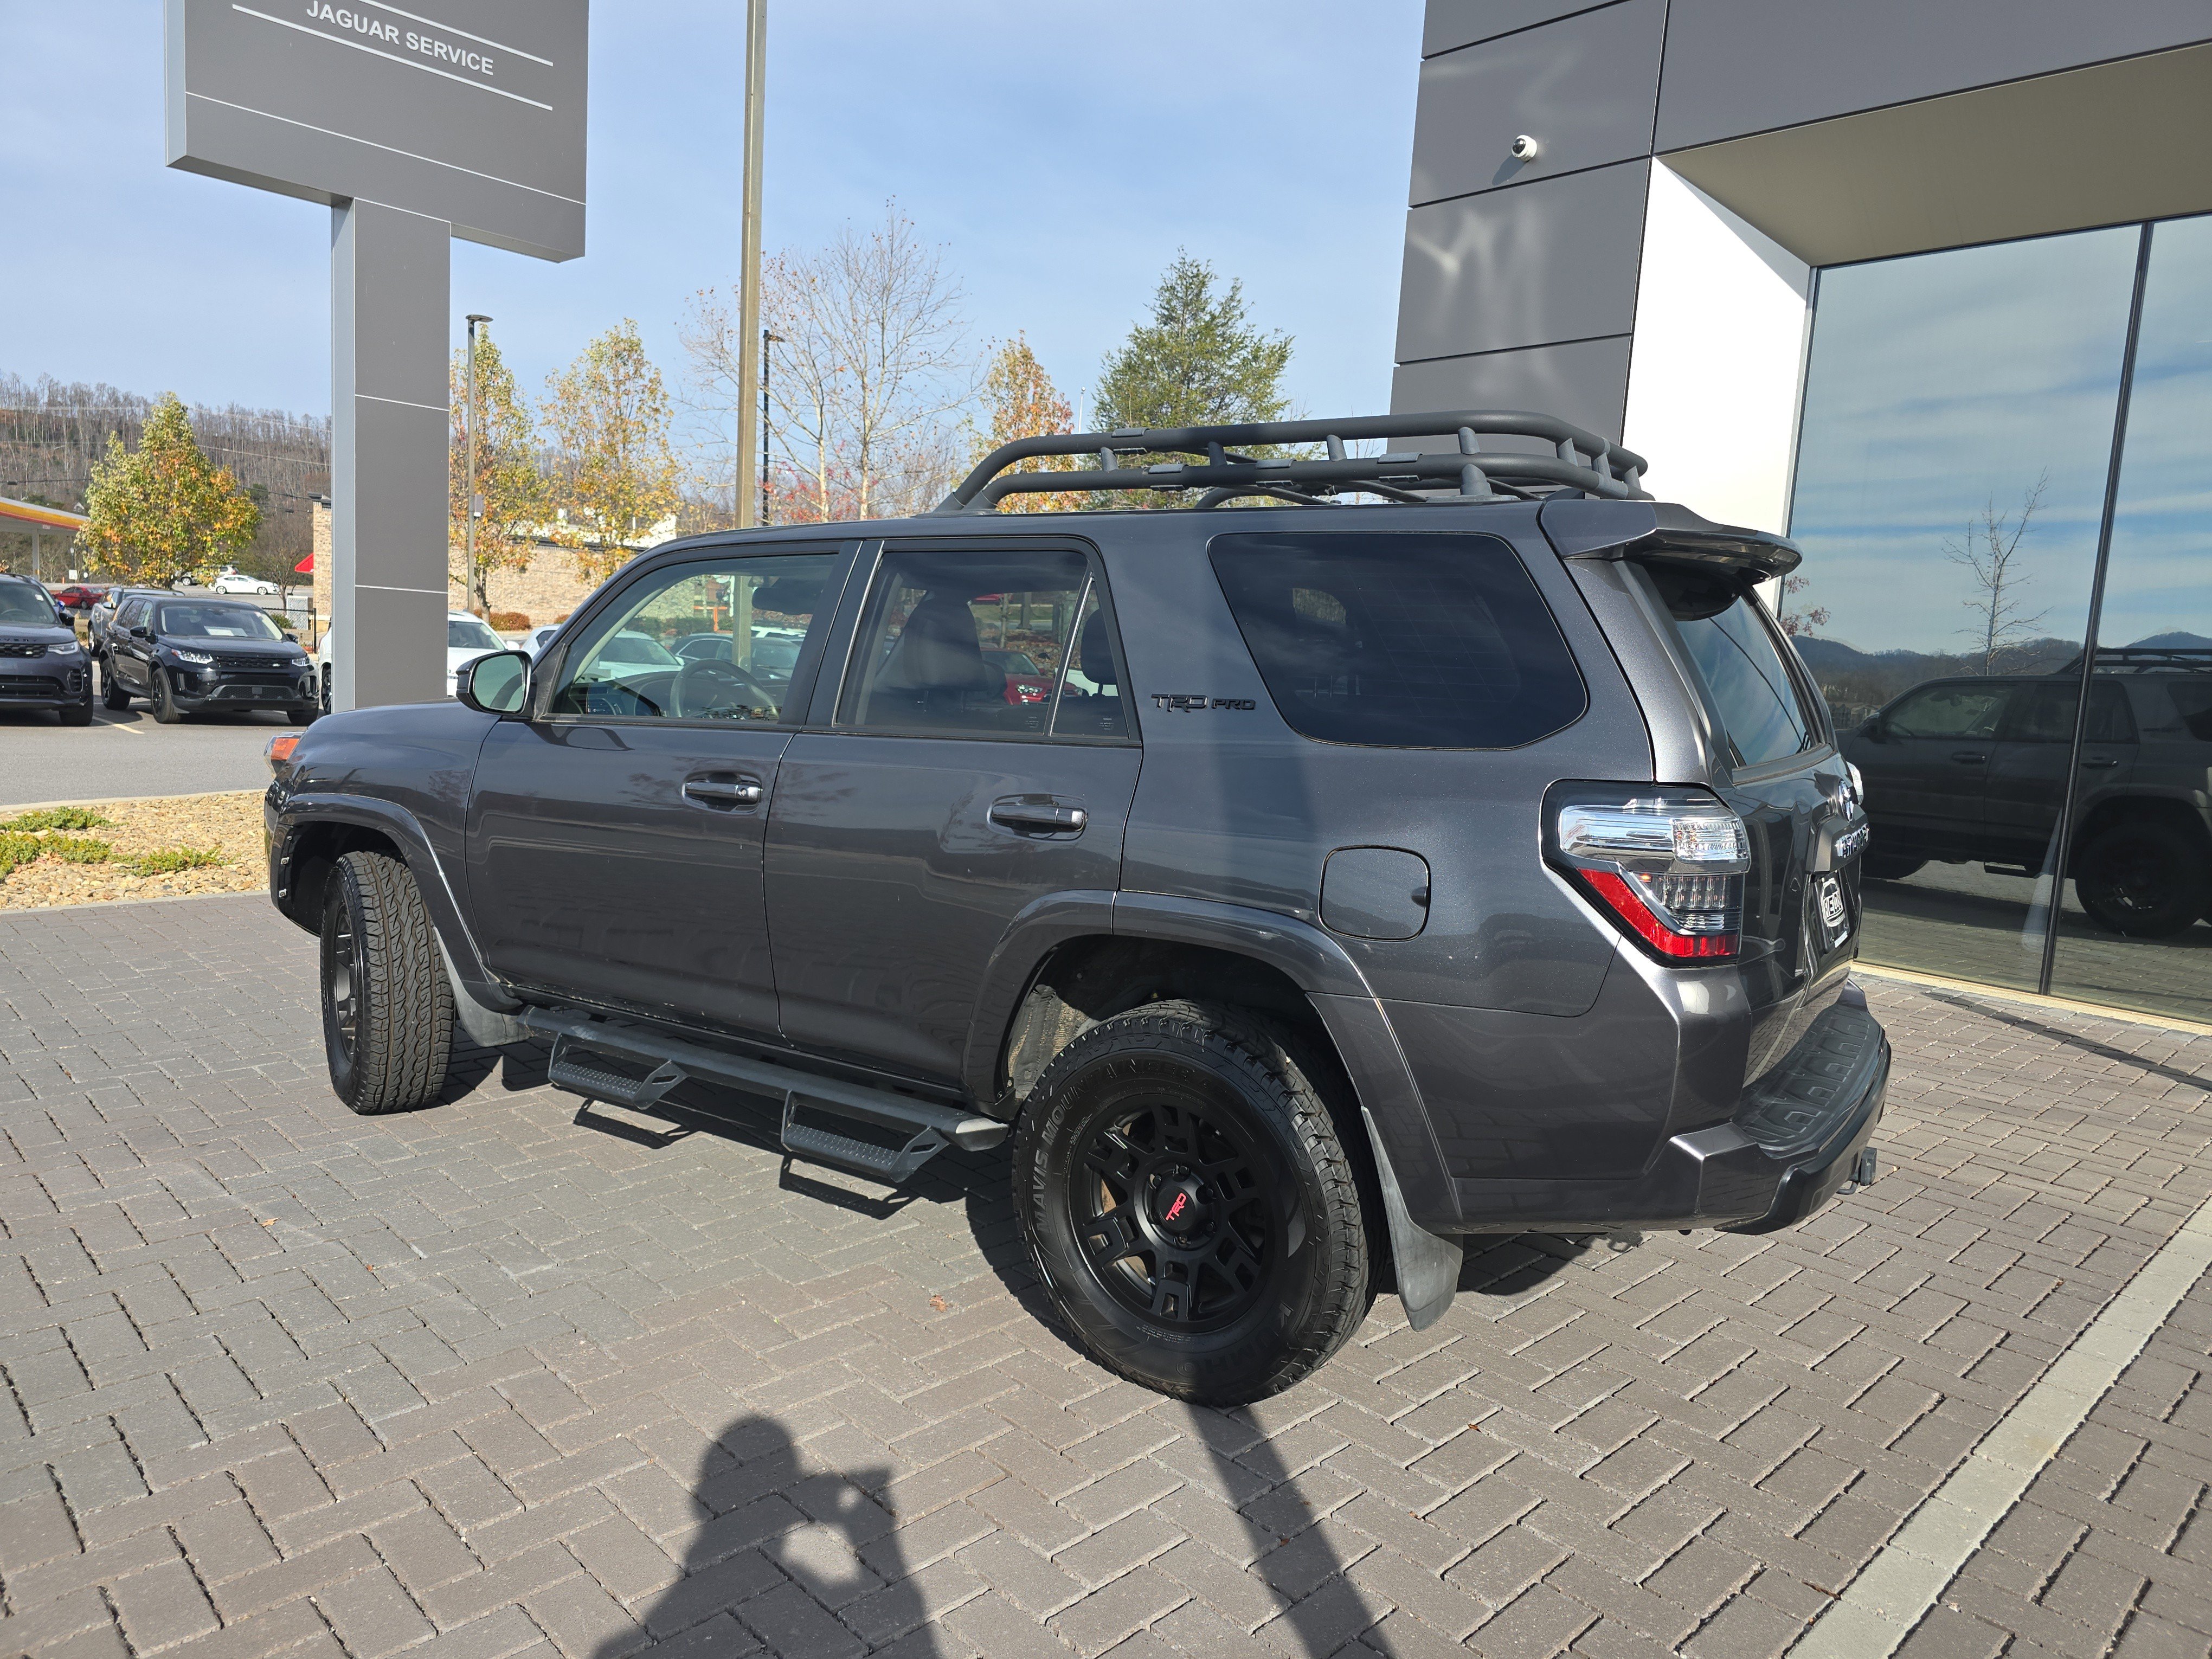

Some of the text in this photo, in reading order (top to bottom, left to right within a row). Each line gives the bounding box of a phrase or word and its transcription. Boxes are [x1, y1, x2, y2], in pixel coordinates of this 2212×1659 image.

[306, 0, 494, 76] JAGUAR SERVICE
[1151, 693, 1256, 713] TRD PRO
[1033, 1148, 1050, 1234] MAVIS
[1166, 1193, 1187, 1221] TRD
